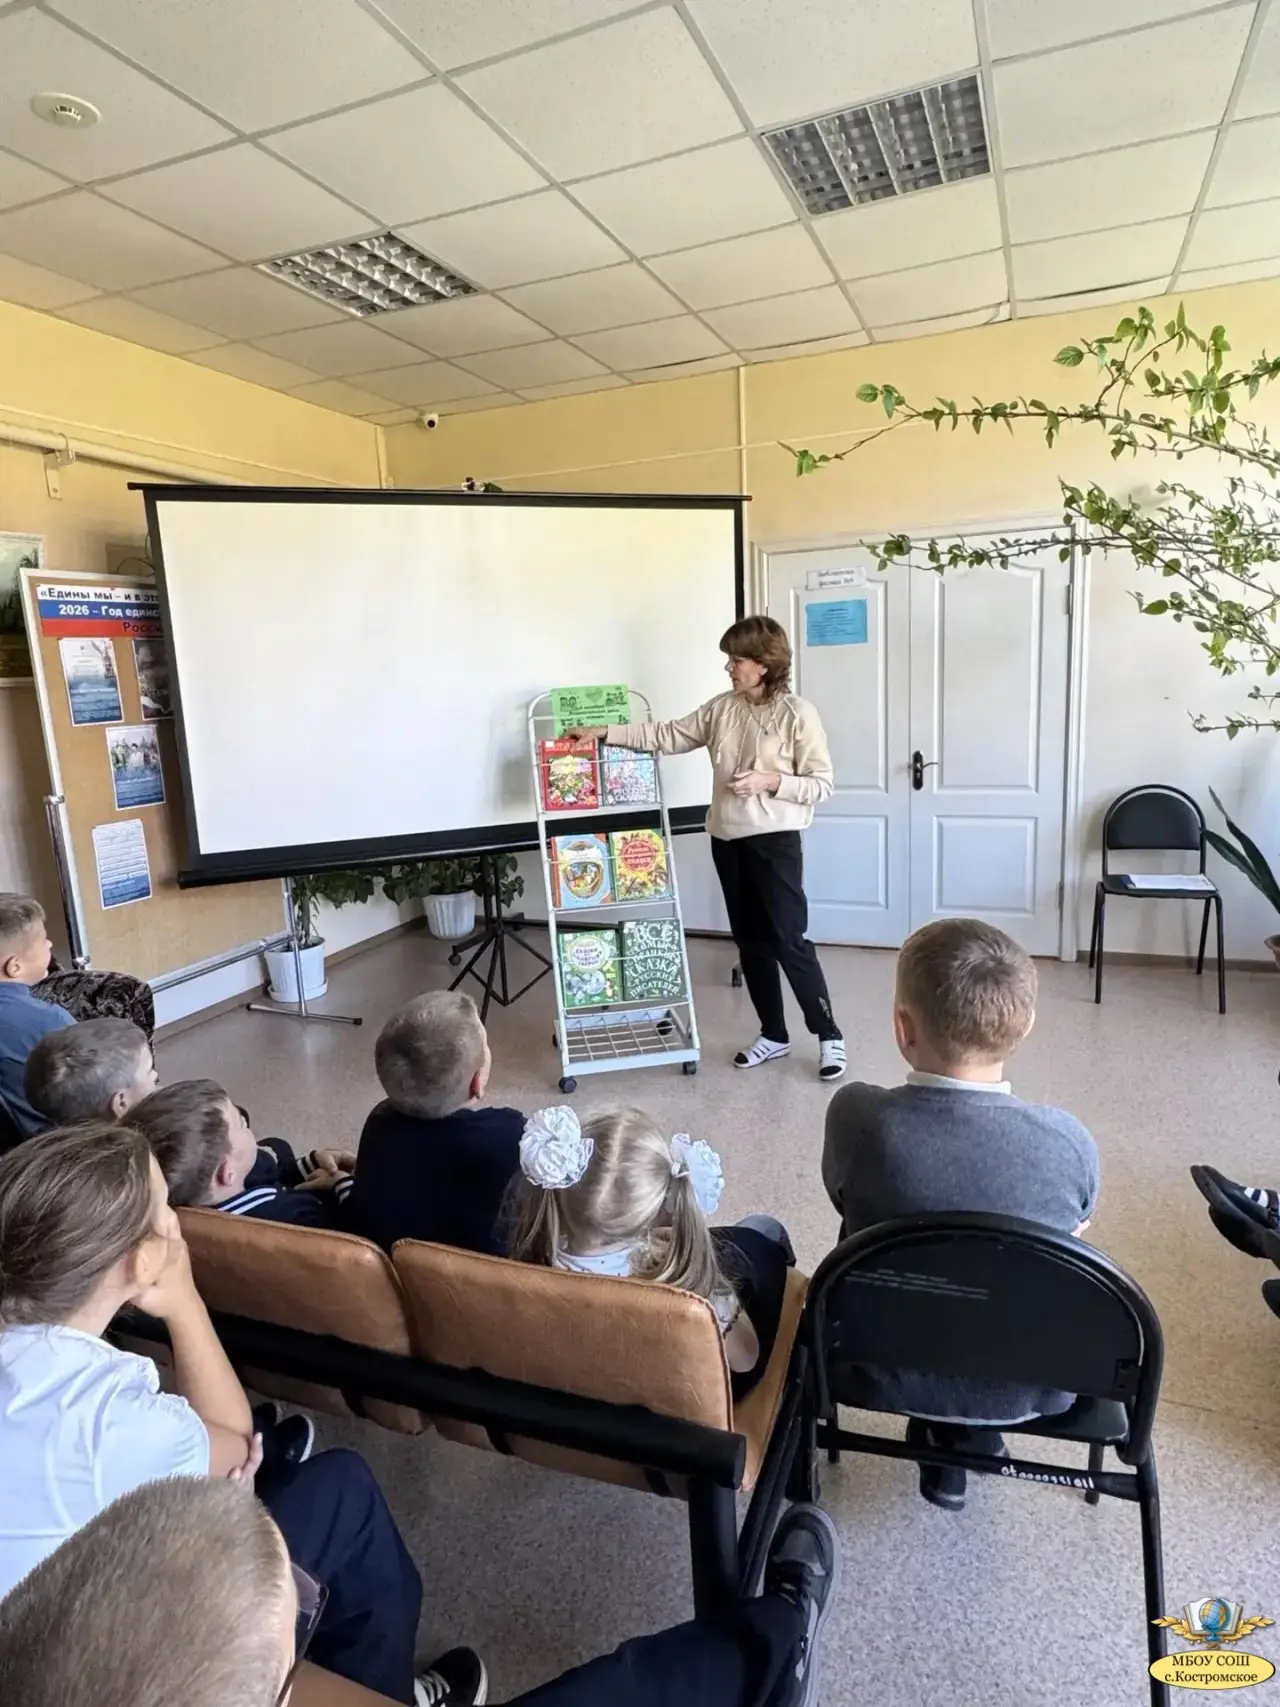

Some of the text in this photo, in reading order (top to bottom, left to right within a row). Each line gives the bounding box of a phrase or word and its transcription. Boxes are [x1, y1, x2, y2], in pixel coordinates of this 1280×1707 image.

[40, 587, 90, 599] «Едины
[94, 591, 113, 600] мы
[124, 593, 132, 601] и
[58, 604, 90, 616] 2026
[101, 605, 123, 618] Год
[125, 607, 160, 617] единс
[632, 922, 674, 942] ВСЕ
[628, 958, 679, 978] СКАЗКИ
